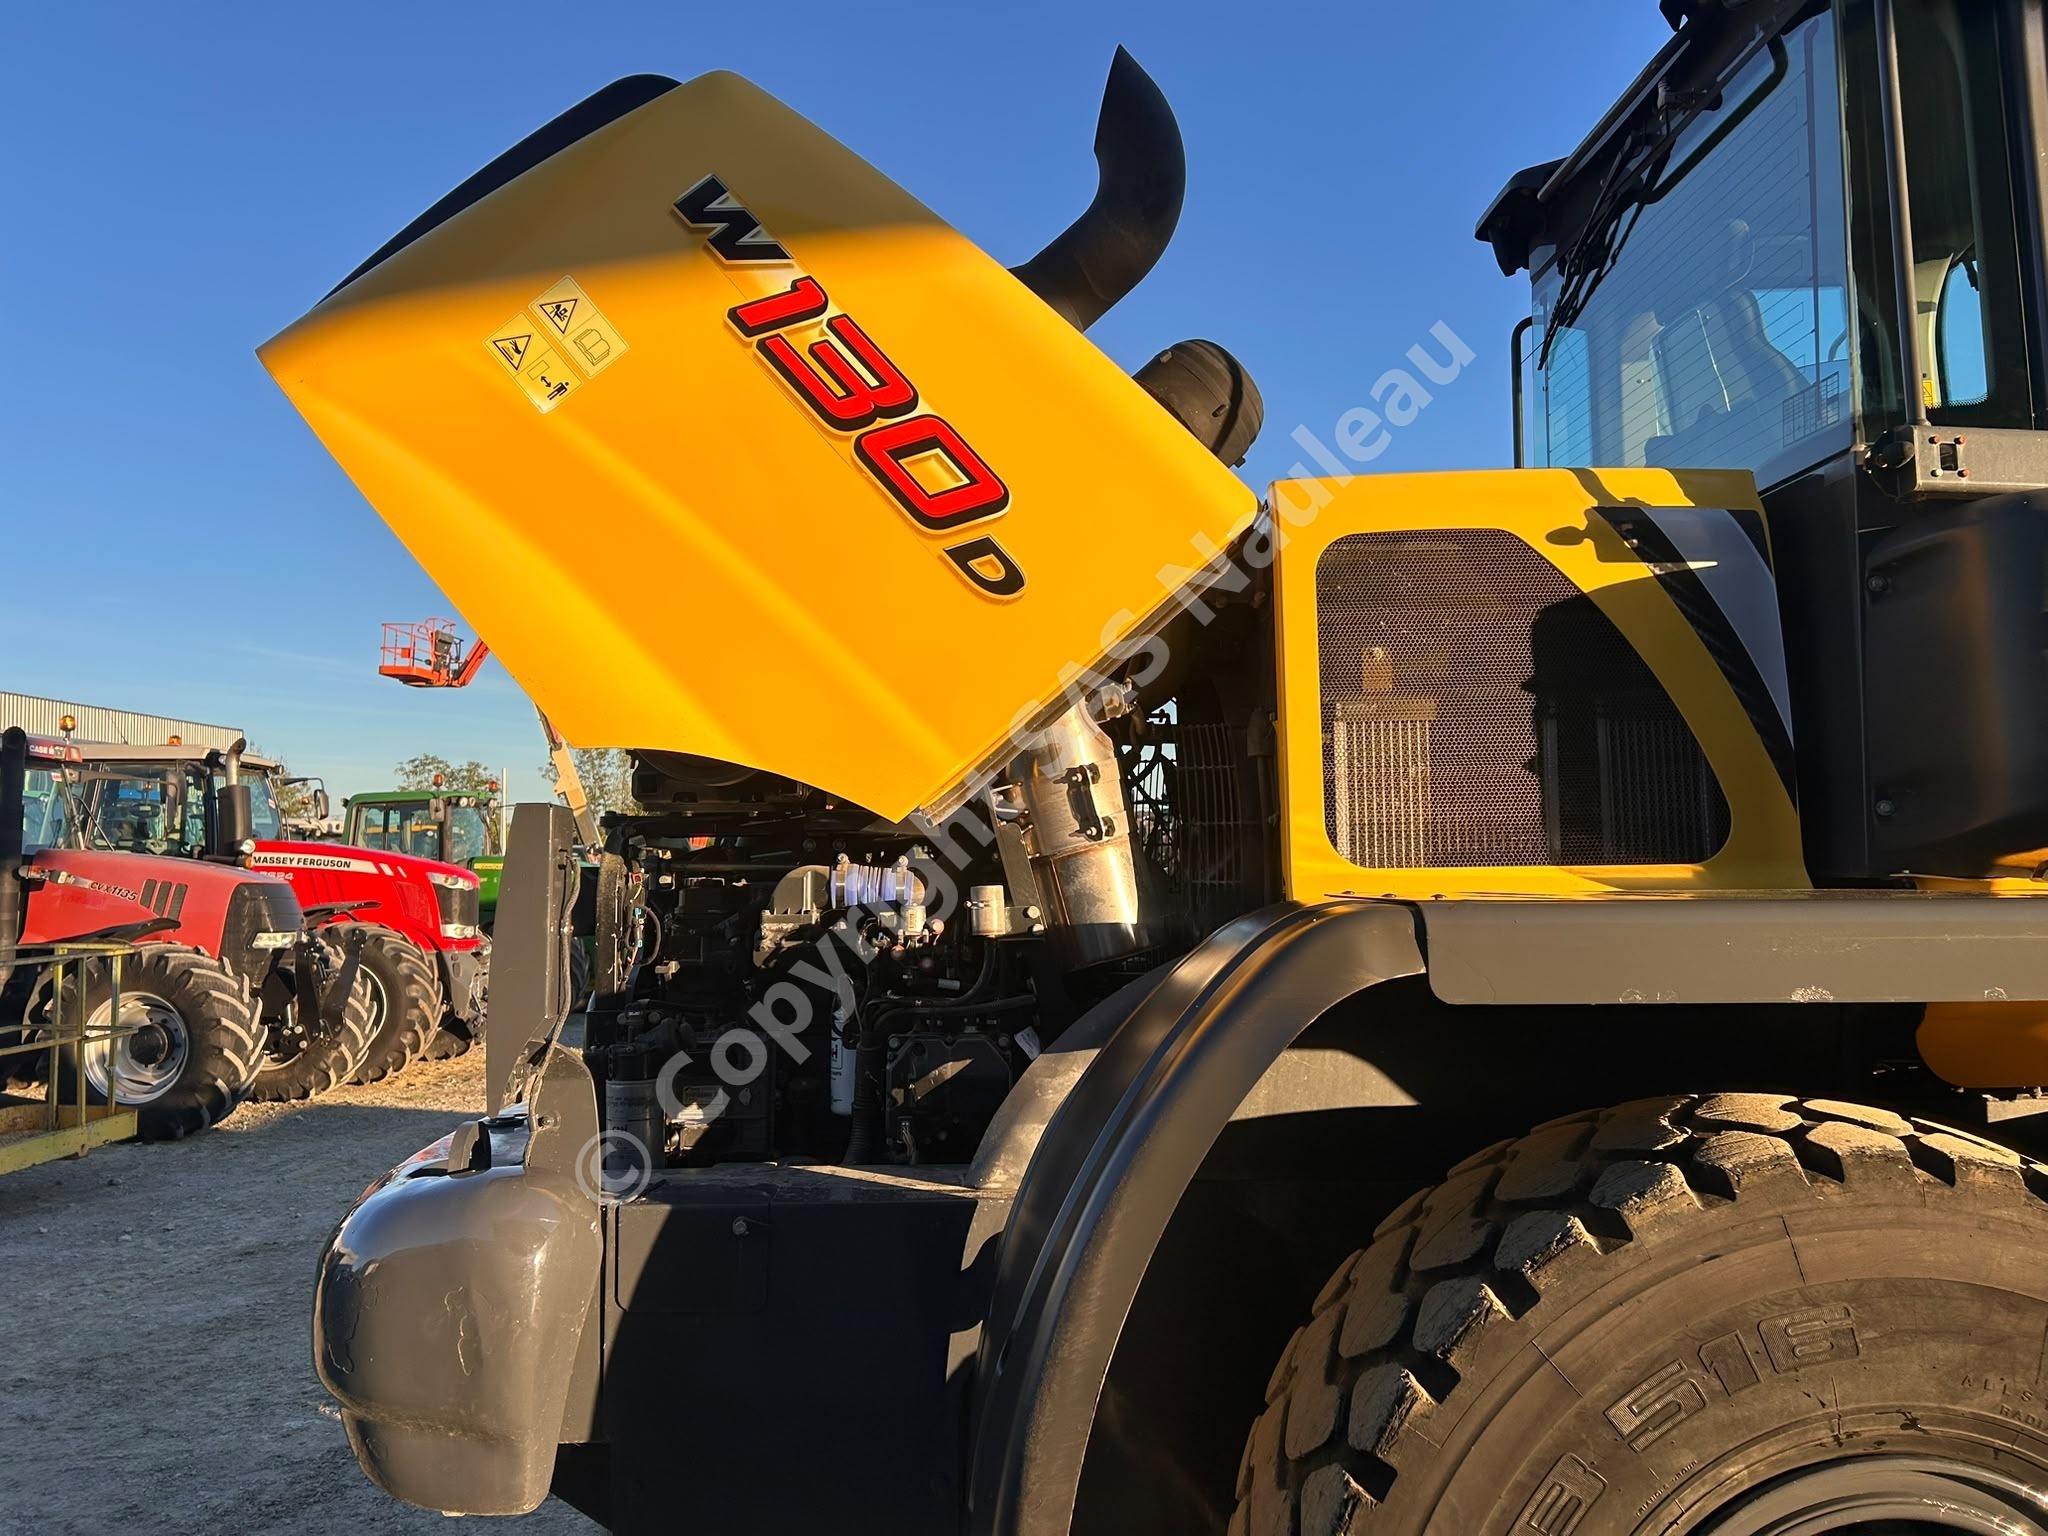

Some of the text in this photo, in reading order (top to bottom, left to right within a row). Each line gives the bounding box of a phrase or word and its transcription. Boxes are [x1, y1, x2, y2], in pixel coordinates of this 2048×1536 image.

[29, 745, 48, 755] CASE
[253, 856, 352, 869] MASSEY FERGUSON
[1601, 1303, 1861, 1455] 516
